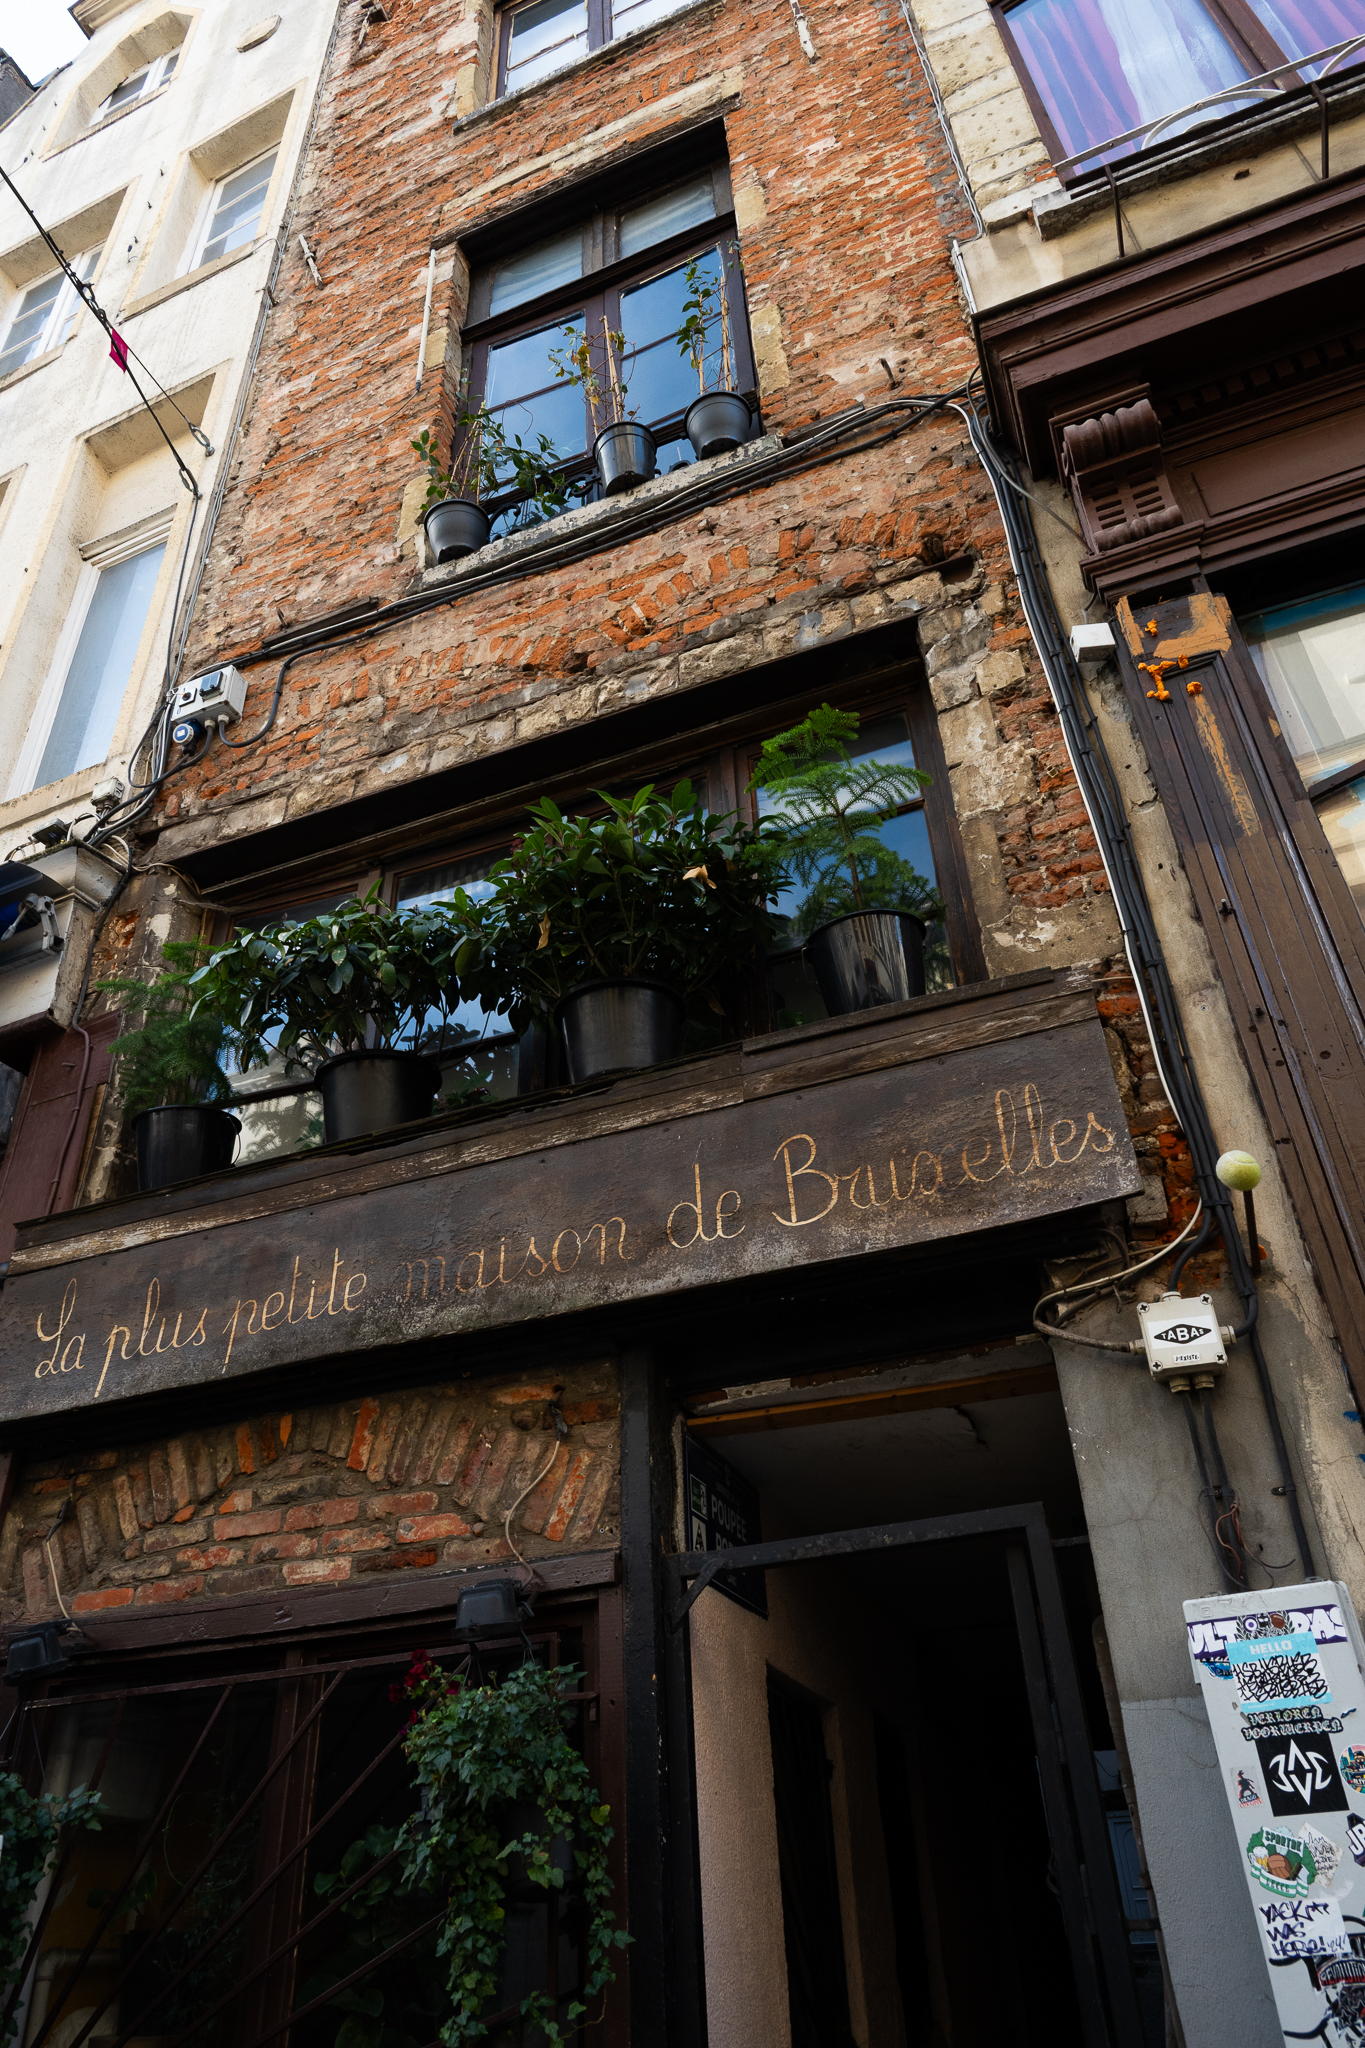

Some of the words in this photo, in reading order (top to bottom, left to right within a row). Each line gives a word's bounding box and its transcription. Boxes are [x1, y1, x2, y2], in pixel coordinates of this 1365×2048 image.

[34, 1277, 87, 1379] La
[94, 1277, 208, 1398] plus
[222, 1247, 367, 1374] petite
[399, 1216, 635, 1302] maison
[666, 1163, 746, 1249] de
[772, 1082, 1116, 1227] Bruxelles
[1161, 1327, 1205, 1342] TABAS
[1249, 1640, 1293, 1655] HELLO
[1249, 1706, 1322, 1726] VERLOREN
[1243, 1717, 1342, 1740] VOORWERPEN
[1264, 1830, 1303, 1853] SPARTAK
[1266, 1922, 1306, 1942] WAS
[1321, 1961, 1365, 1985] REVOLUTIO
